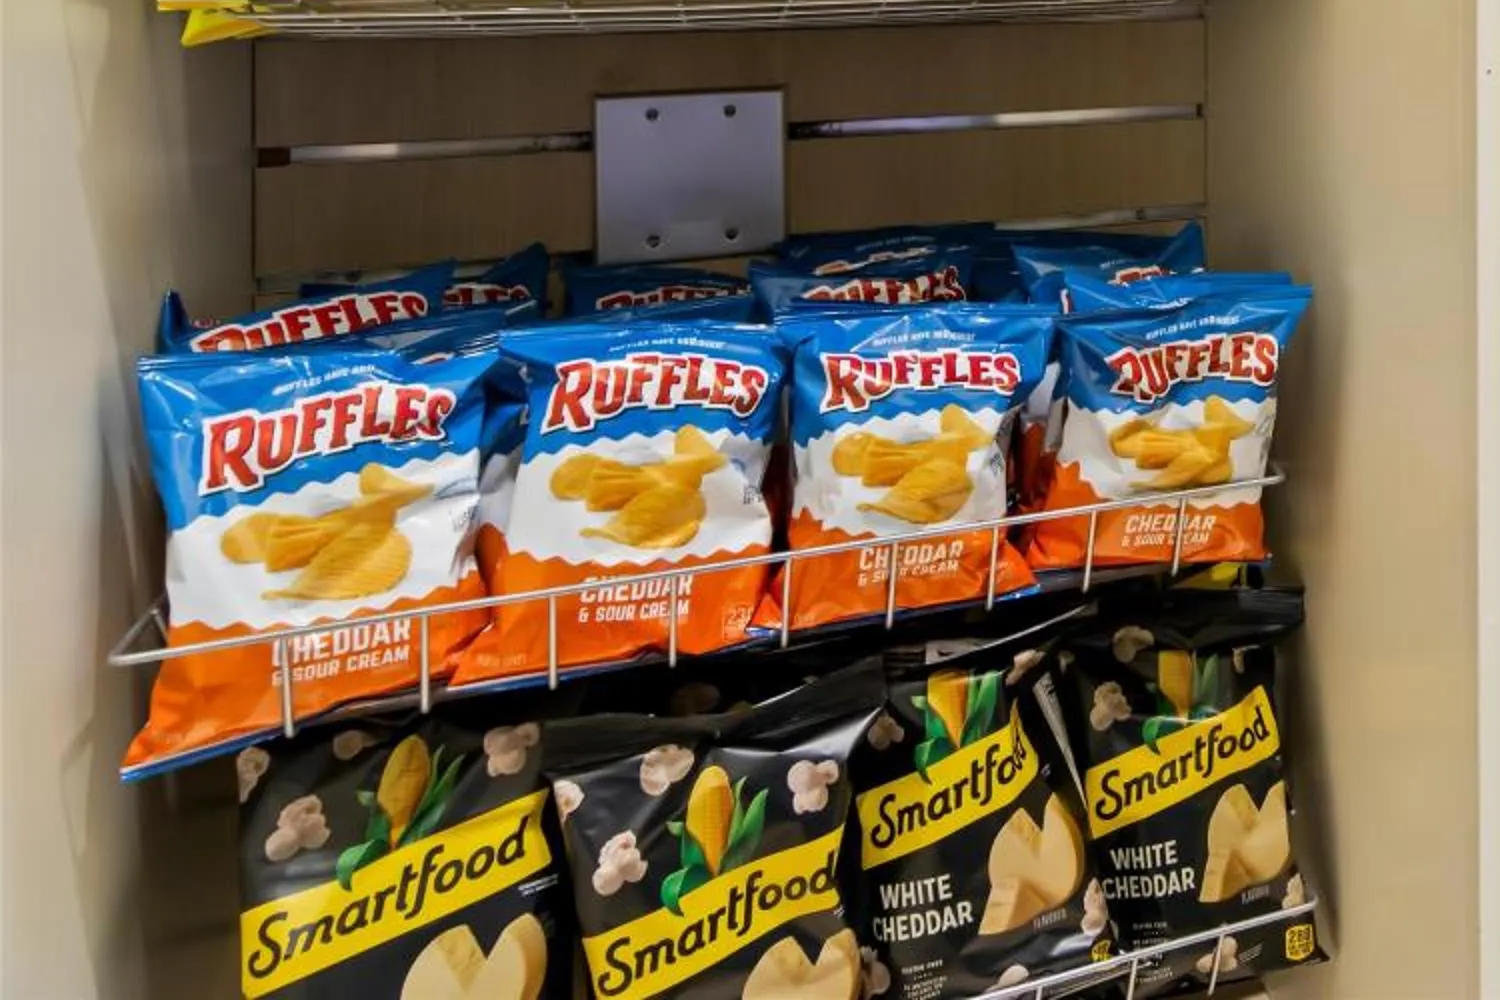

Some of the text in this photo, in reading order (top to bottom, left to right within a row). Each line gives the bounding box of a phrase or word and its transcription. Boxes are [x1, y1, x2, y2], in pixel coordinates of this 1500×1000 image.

[543, 353, 767, 433] RUFFLES
[821, 350, 1021, 412] RUFFLES
[1106, 333, 1279, 402] RUFFLES
[200, 381, 455, 495] RUFFLES
[1167, 531, 1210, 546] CEAM
[594, 604, 635, 622] SOUR
[292, 659, 339, 681] SOUR
[346, 644, 410, 672] CREAM
[1095, 705, 1271, 821] Smartfood
[1110, 839, 1179, 871] WHITE
[247, 816, 530, 979] Smartfood
[879, 873, 953, 910] WHITE
[1103, 867, 1196, 900] CHEDDAR
[597, 850, 838, 997] Smartfood
[872, 901, 974, 943] CHEDDAR
